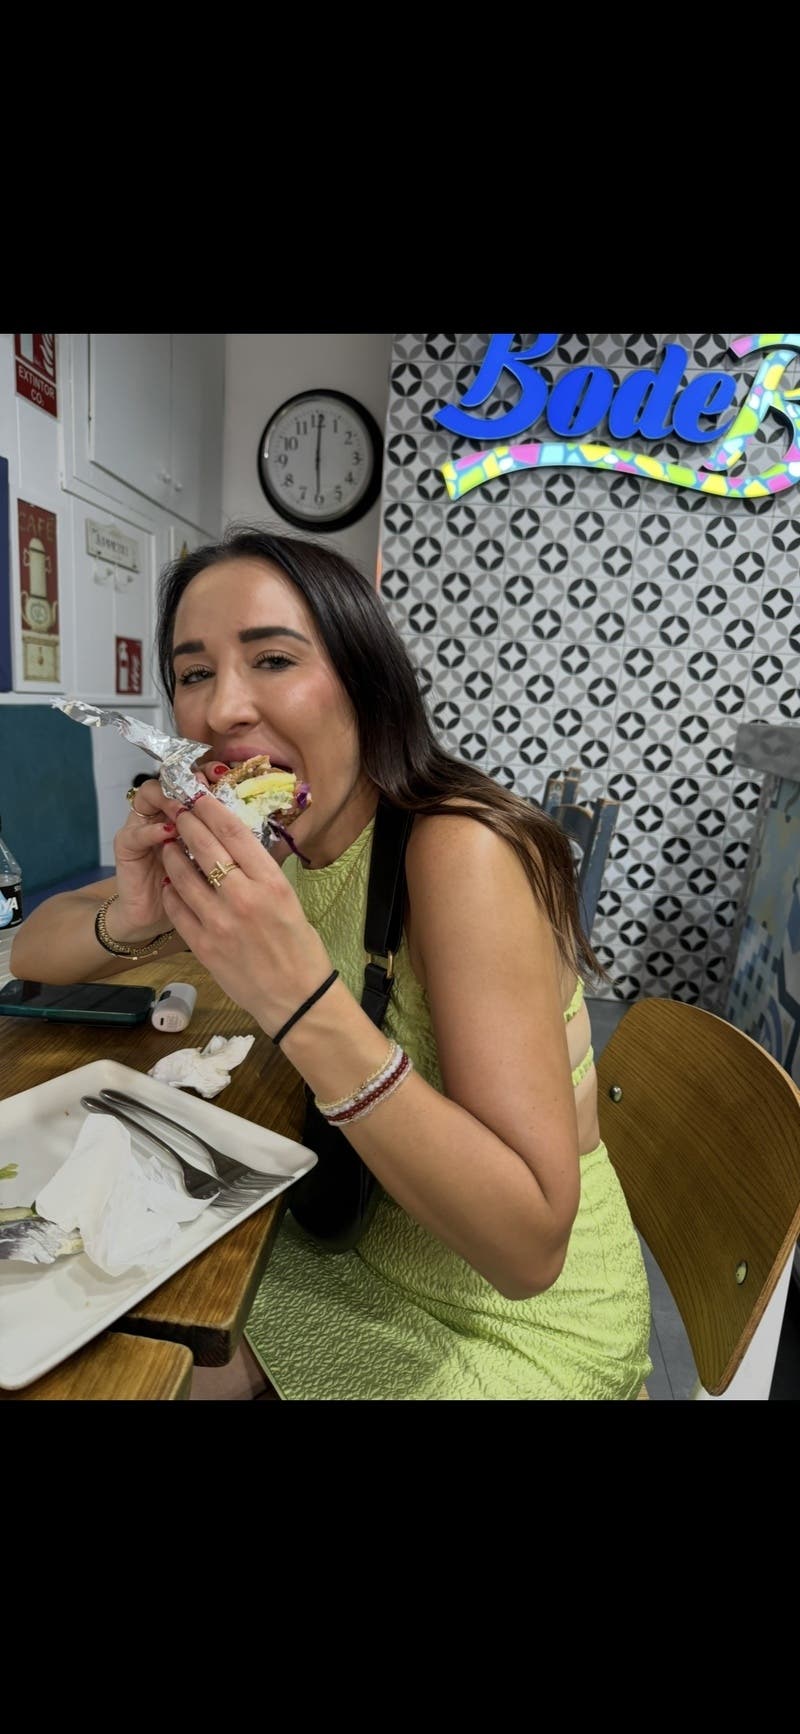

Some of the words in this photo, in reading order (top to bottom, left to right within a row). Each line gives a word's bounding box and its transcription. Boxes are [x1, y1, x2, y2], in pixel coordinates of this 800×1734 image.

[18, 364, 55, 400] EXTINTOR
[295, 420, 308, 436] 11
[310, 413, 326, 429] 12
[333, 419, 338, 434] 1
[284, 436, 299, 451] 10
[344, 431, 353, 446] 2
[278, 454, 288, 468] 9
[352, 451, 361, 466] 3
[284, 473, 294, 487] 8
[344, 472, 355, 484] 4
[299, 486, 308, 500] 7
[335, 485, 342, 502] 5
